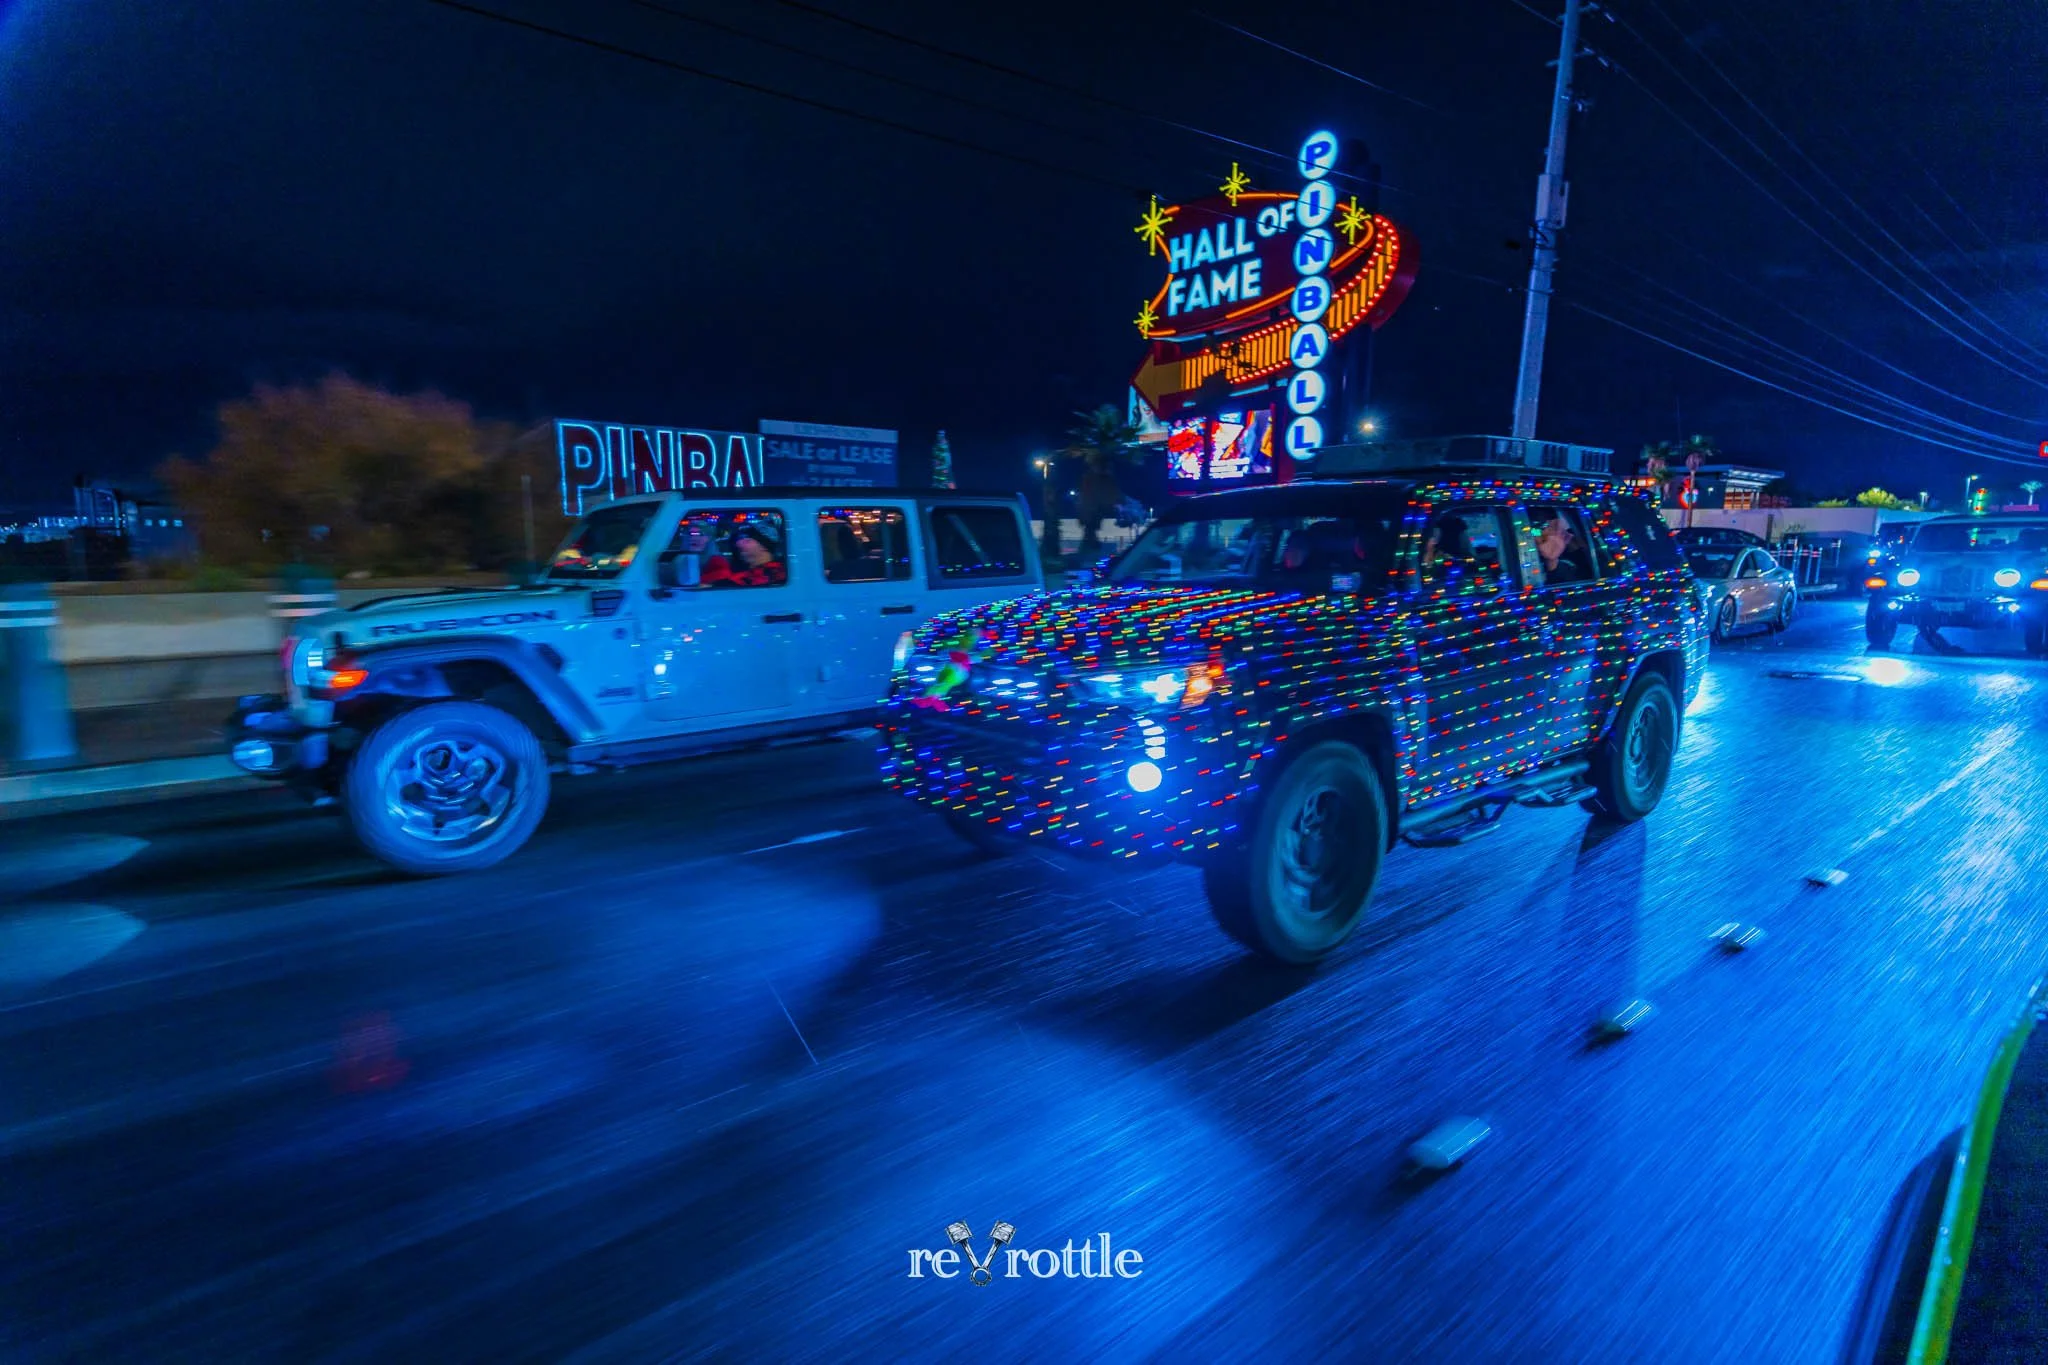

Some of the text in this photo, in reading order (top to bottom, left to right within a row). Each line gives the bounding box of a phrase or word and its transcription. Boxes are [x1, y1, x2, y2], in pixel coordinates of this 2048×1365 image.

[1169, 200, 1297, 274] HALL OF
[1168, 258, 1262, 316] FAME
[1291, 139, 1333, 450] PINBALL
[558, 421, 764, 517] PINBA
[766, 440, 816, 460] SALE
[839, 445, 893, 464] LEASE
[371, 609, 557, 638] RUBICON
